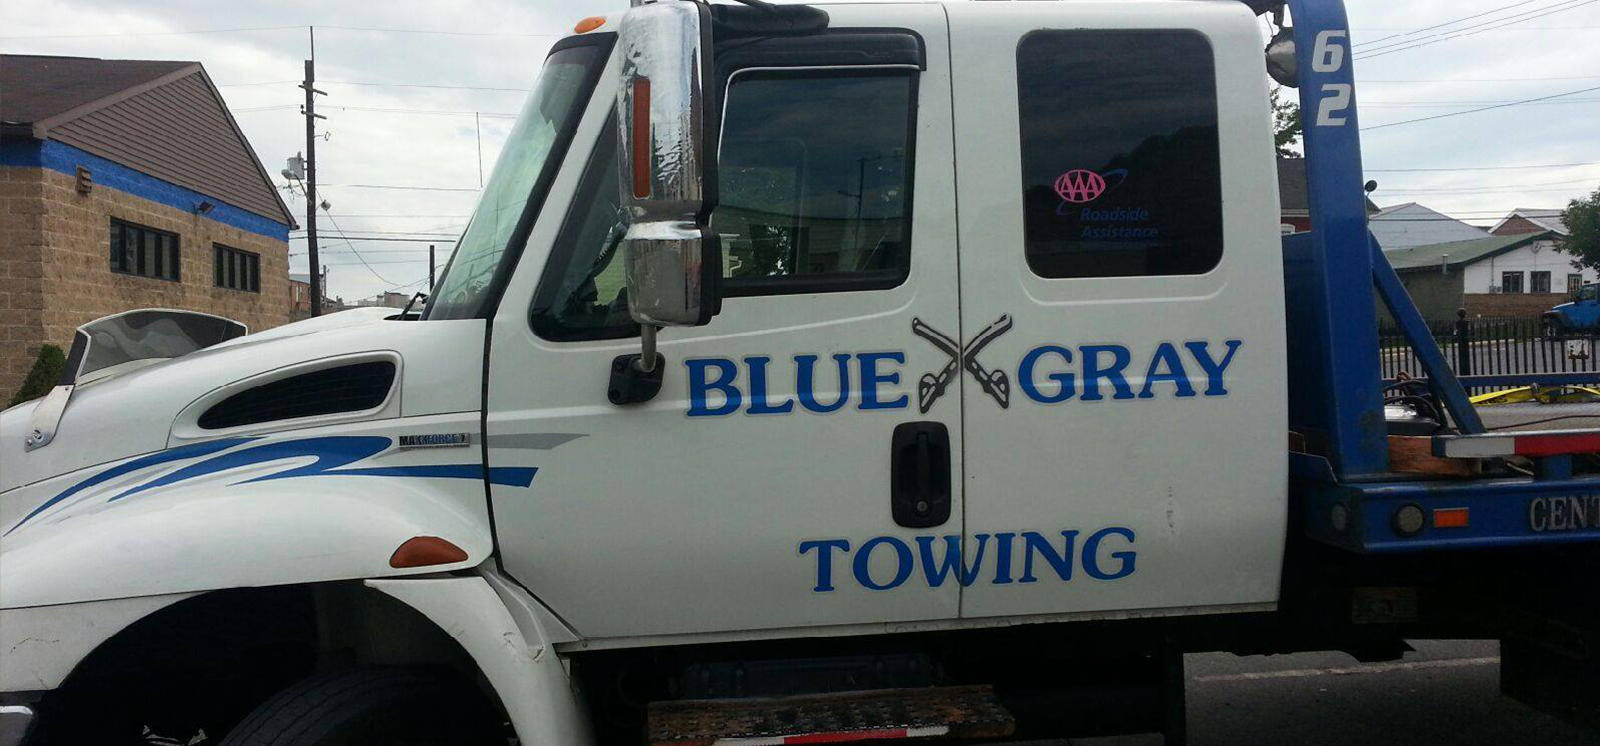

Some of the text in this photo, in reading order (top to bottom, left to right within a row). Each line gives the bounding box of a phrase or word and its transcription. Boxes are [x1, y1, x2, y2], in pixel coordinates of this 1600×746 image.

[1312, 29, 1351, 126] 62
[1060, 169, 1101, 201] AAA
[1081, 207, 1149, 220] Roadside
[1082, 225, 1158, 238] Assistance
[685, 340, 1242, 418] BLUE GRAY
[799, 527, 1137, 593] TOWING
